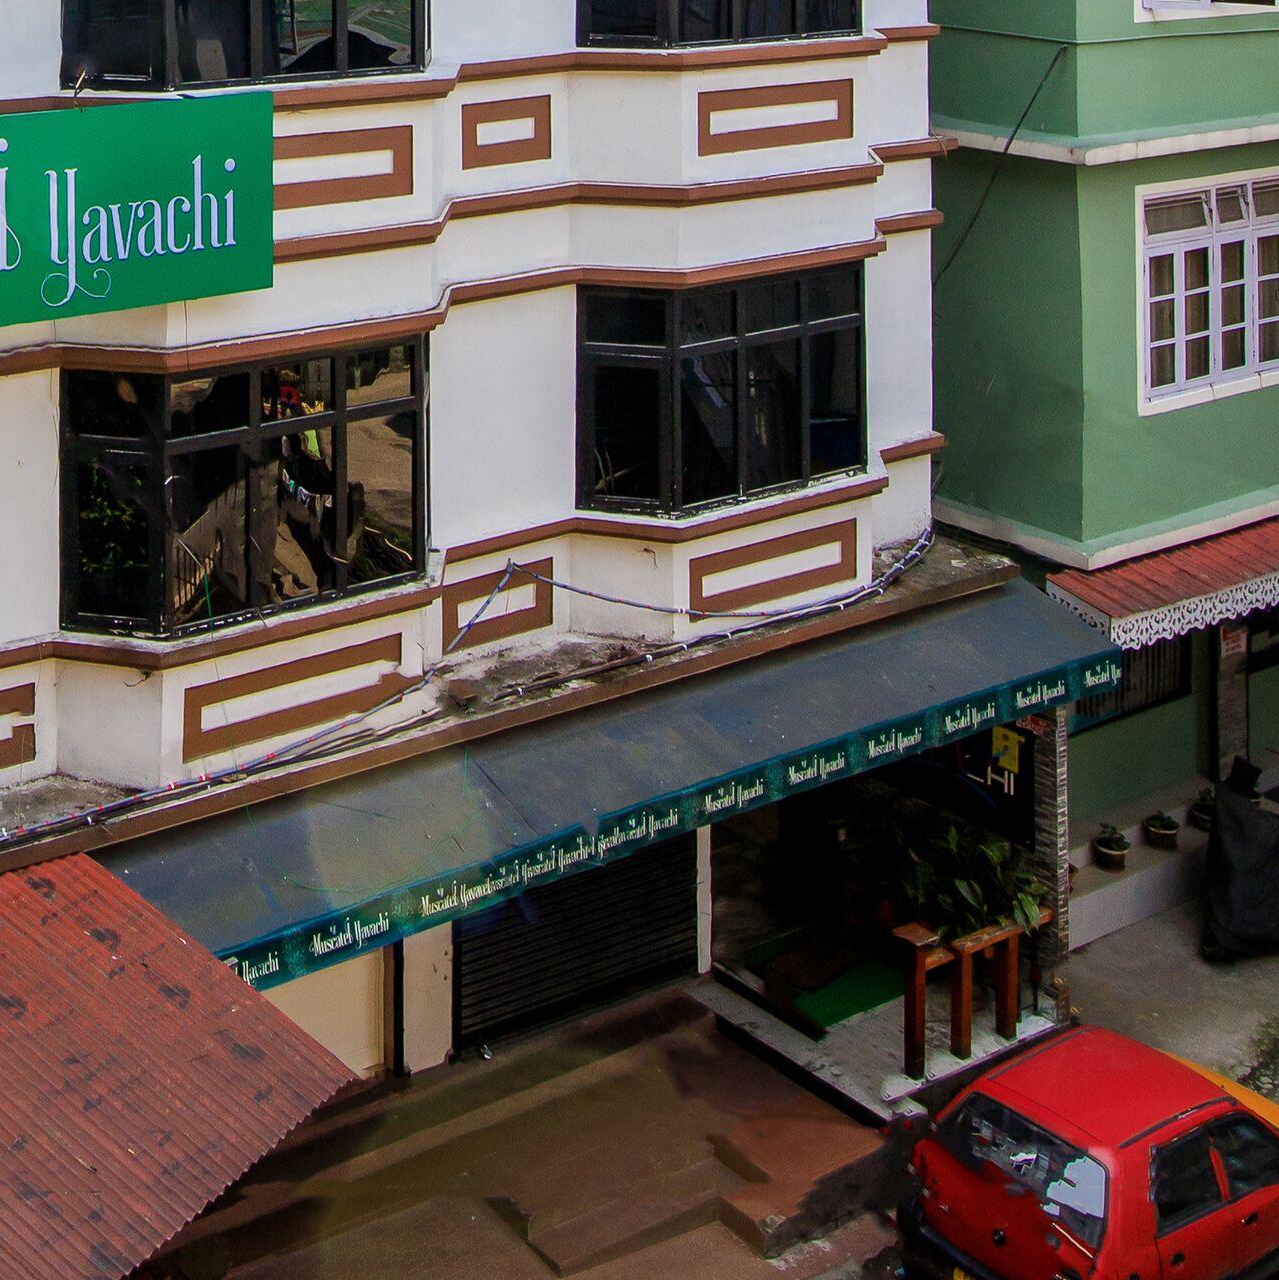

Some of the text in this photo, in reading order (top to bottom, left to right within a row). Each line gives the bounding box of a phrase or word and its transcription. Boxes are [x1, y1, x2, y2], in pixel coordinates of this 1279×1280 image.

[41, 154, 237, 307] Yavachi
[309, 911, 389, 957] Muscatel Yavachi
